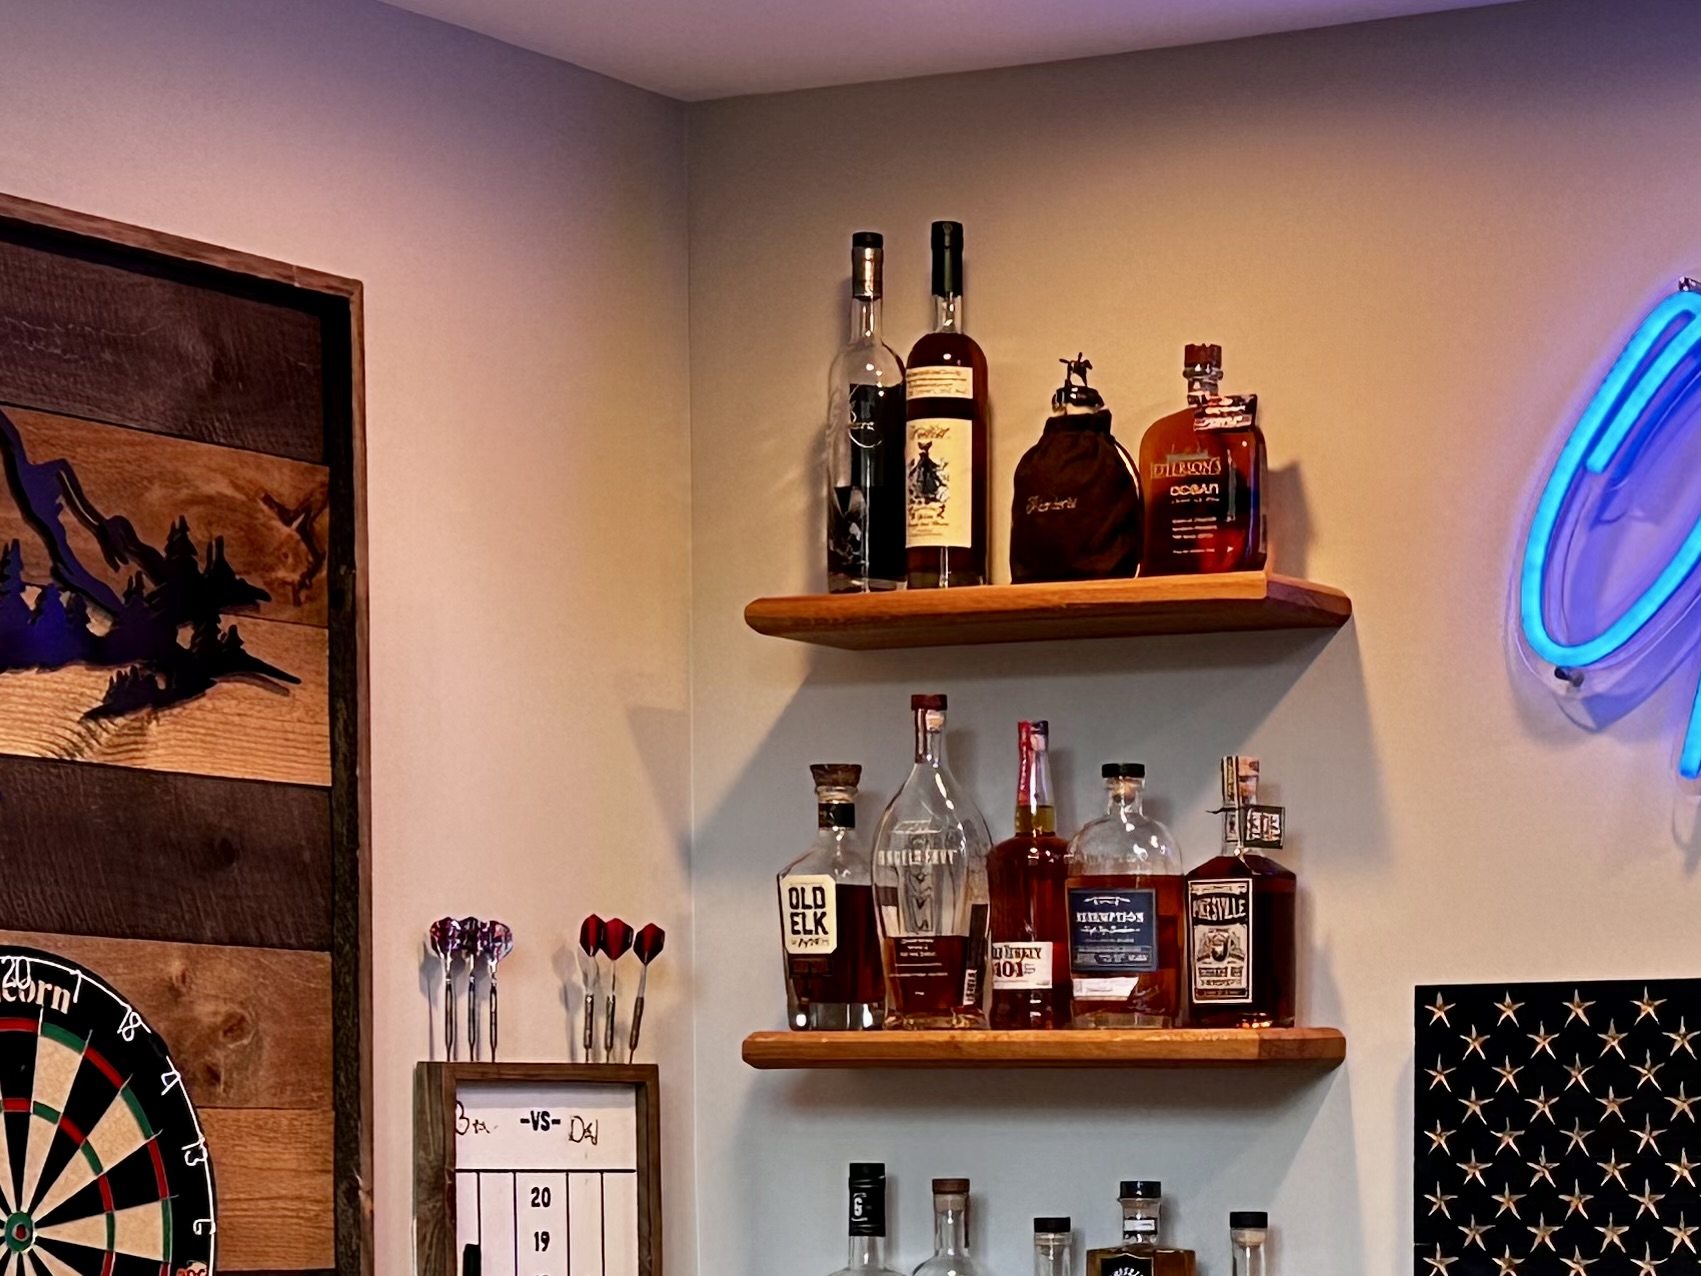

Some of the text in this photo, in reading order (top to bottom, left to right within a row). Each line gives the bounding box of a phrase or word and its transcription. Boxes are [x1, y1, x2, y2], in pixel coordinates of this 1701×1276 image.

[788, 886, 825, 911] OLD
[790, 911, 829, 935] ELK
[531, 1187, 551, 1208] 20
[534, 1231, 550, 1252] 19
